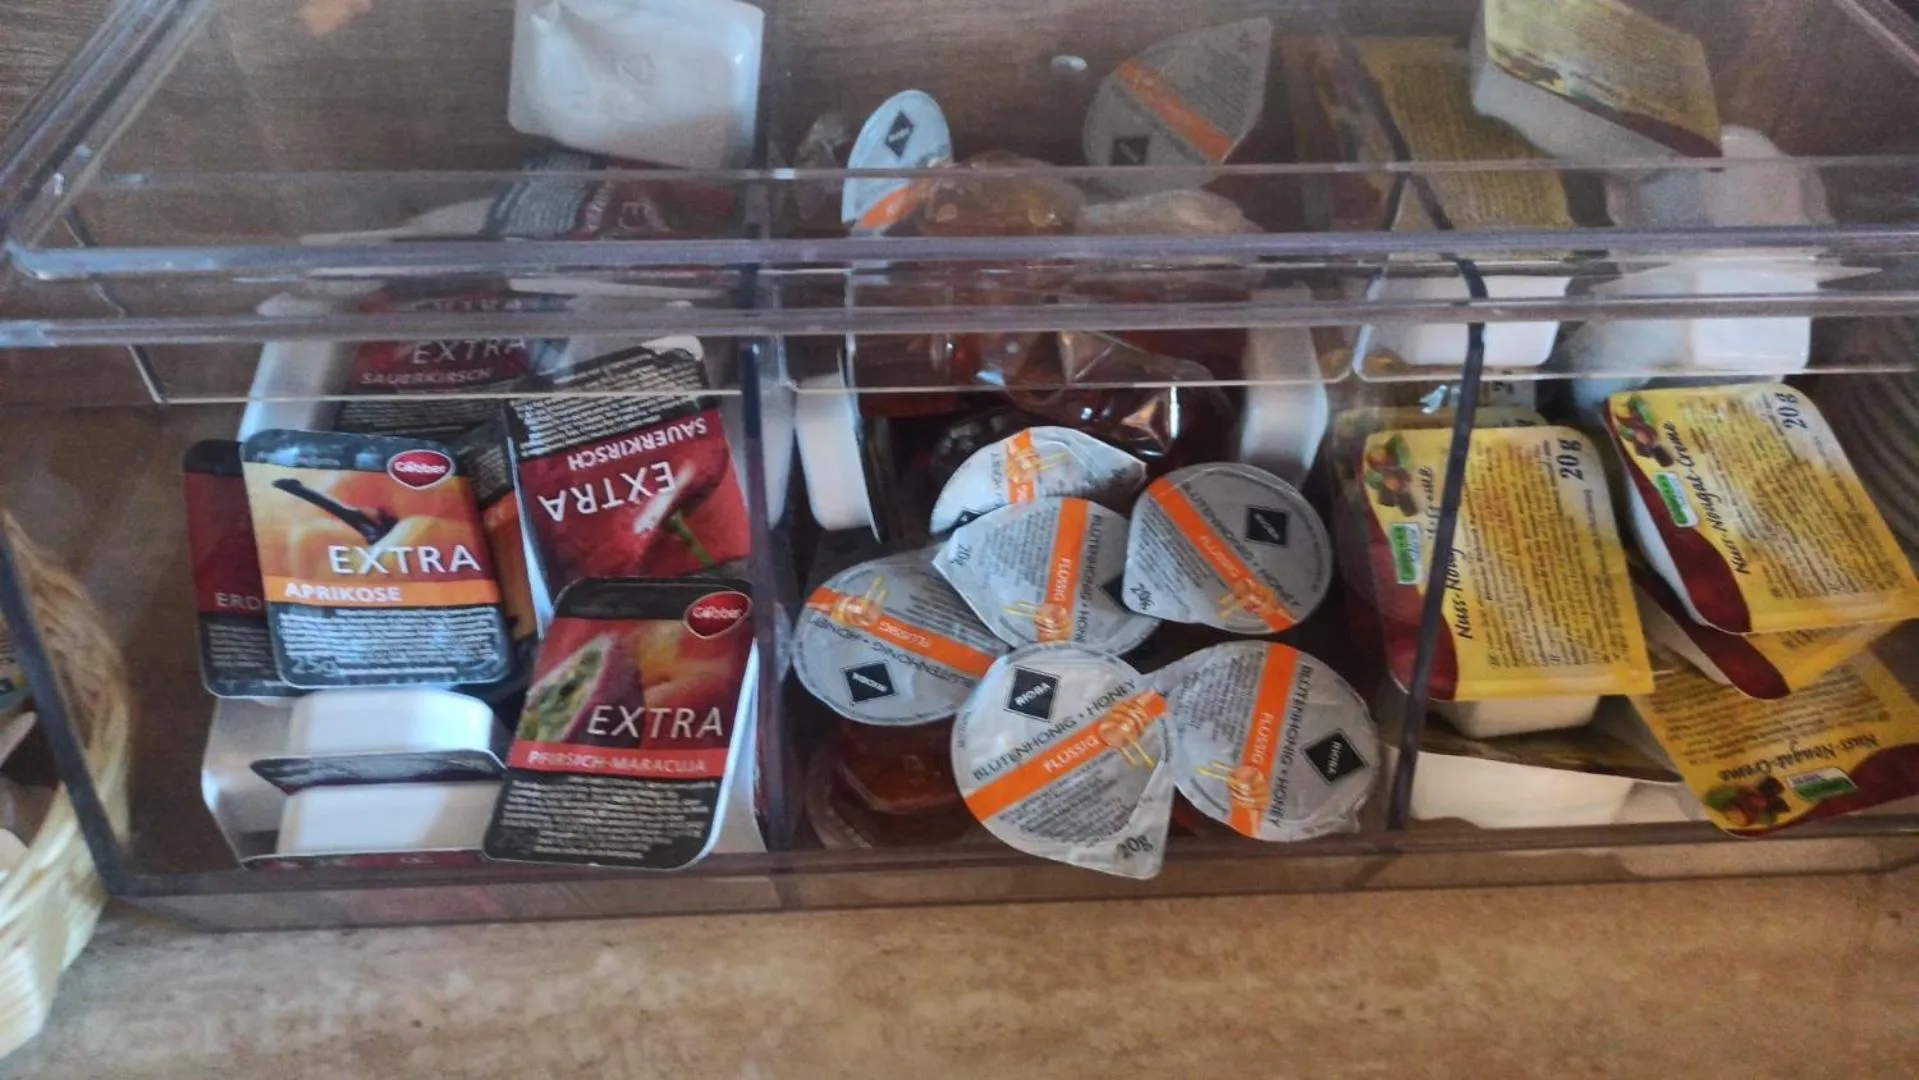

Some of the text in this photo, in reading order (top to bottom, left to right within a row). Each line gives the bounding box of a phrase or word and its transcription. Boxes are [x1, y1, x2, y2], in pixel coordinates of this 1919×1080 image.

[412, 335, 527, 364] EXTRA
[1777, 405, 1807, 431] 20
[566, 417, 708, 471] SAUERKIRSCH
[1558, 455, 1585, 481] 20
[537, 460, 676, 523] EXTRA
[327, 545, 482, 575] EXTRA
[283, 582, 403, 602] APRIKOSE
[586, 705, 724, 739] EXTRA
[526, 750, 708, 773] PFIRSICH-MARACUJA
